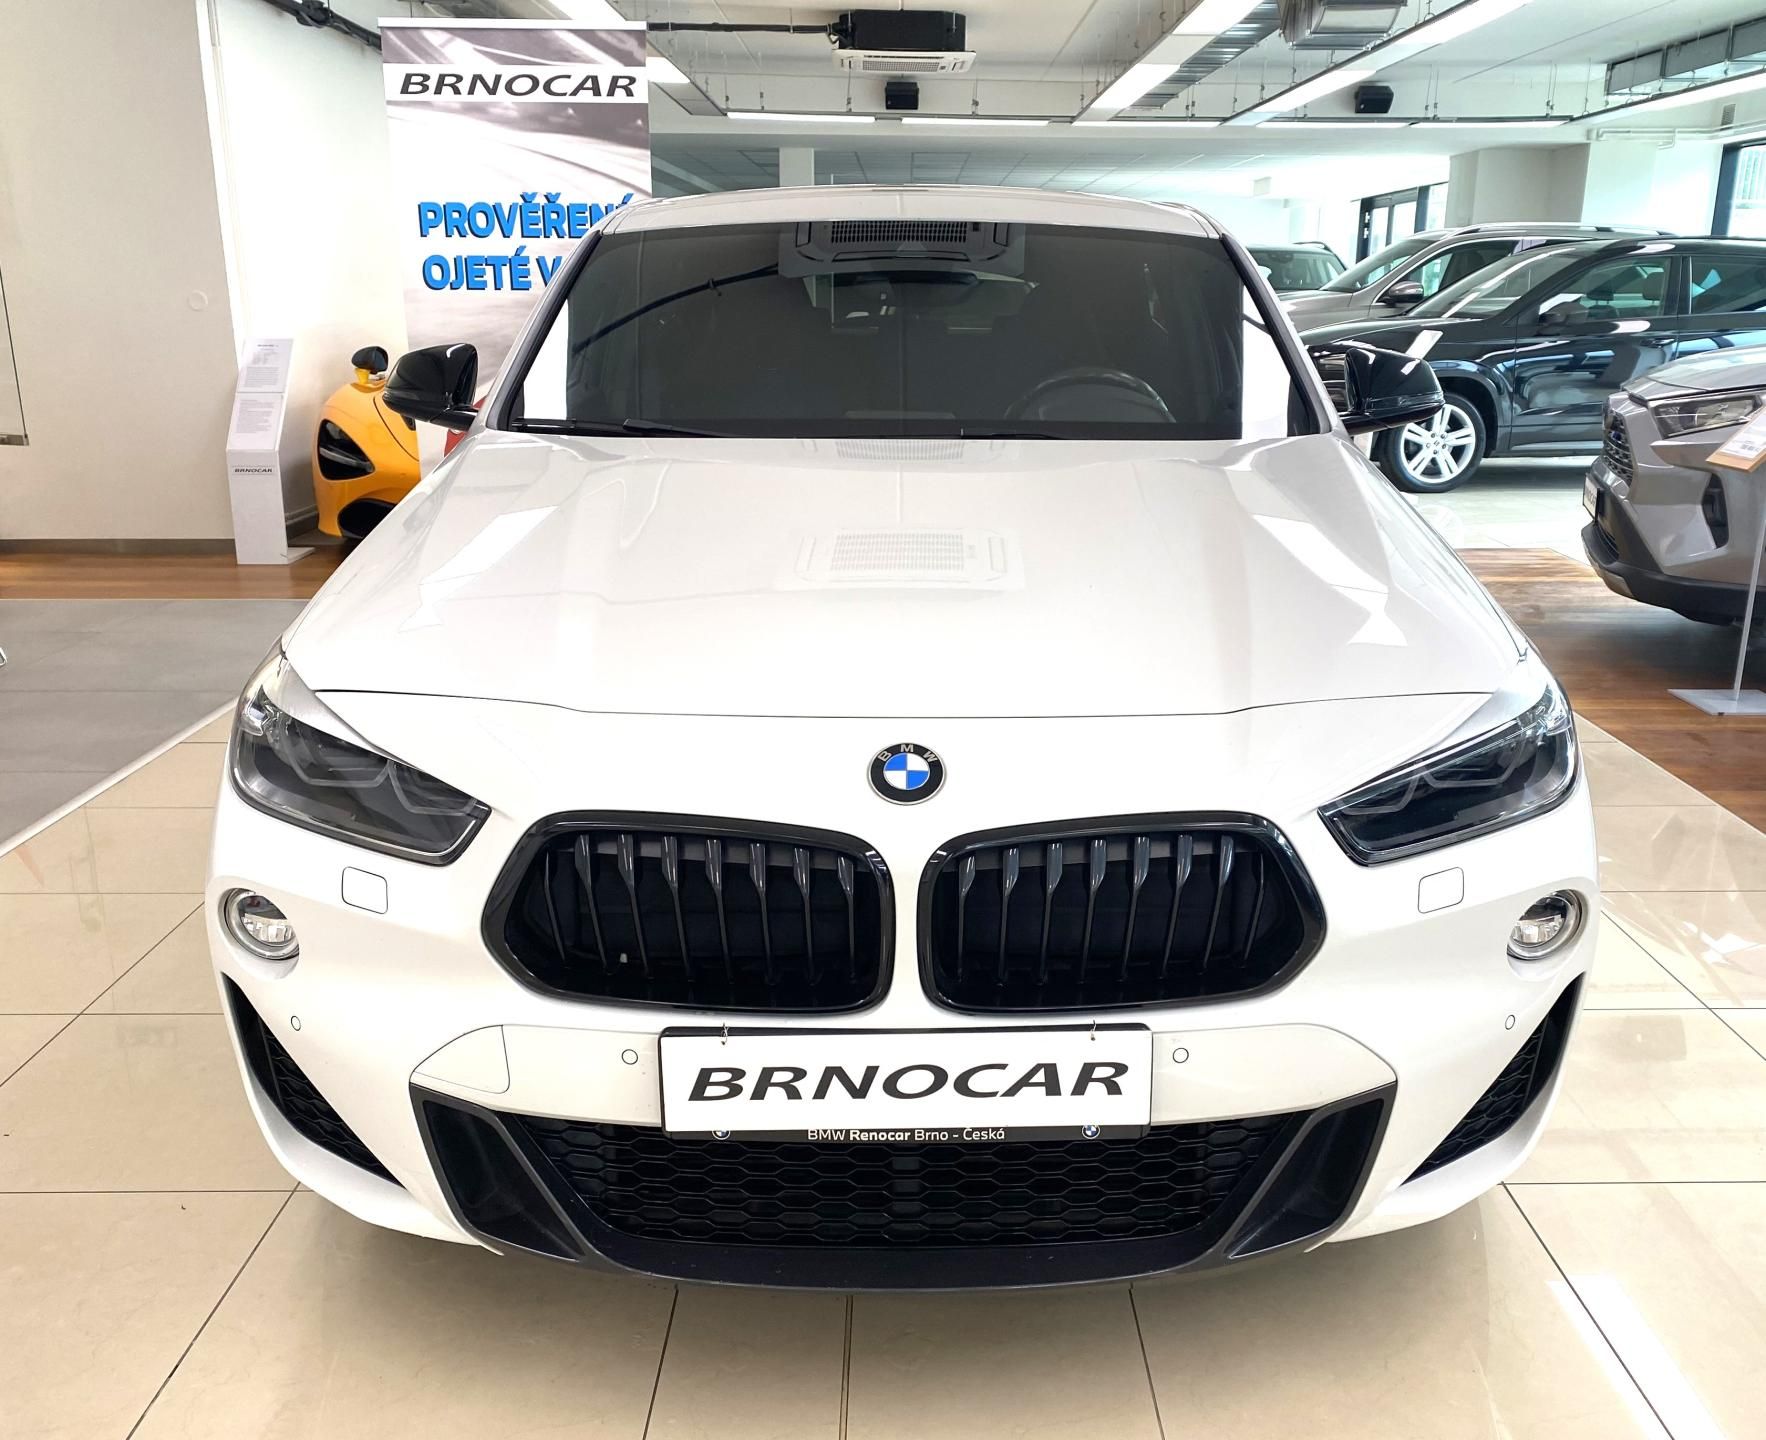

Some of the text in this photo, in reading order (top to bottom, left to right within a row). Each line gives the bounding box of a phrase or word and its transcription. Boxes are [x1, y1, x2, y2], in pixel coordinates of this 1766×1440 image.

[400, 73, 636, 97] BRNOCAR
[418, 192, 634, 239] PROVĚŘEN
[422, 245, 532, 290] OJETÉ
[877, 743, 939, 763] BMW
[688, 1062, 1129, 1102] BRNOCAR
[807, 1129, 846, 1141] BMW
[849, 1129, 911, 1141] Renocar
[914, 1129, 949, 1141] Brno
[962, 1127, 1005, 1140] Česká
